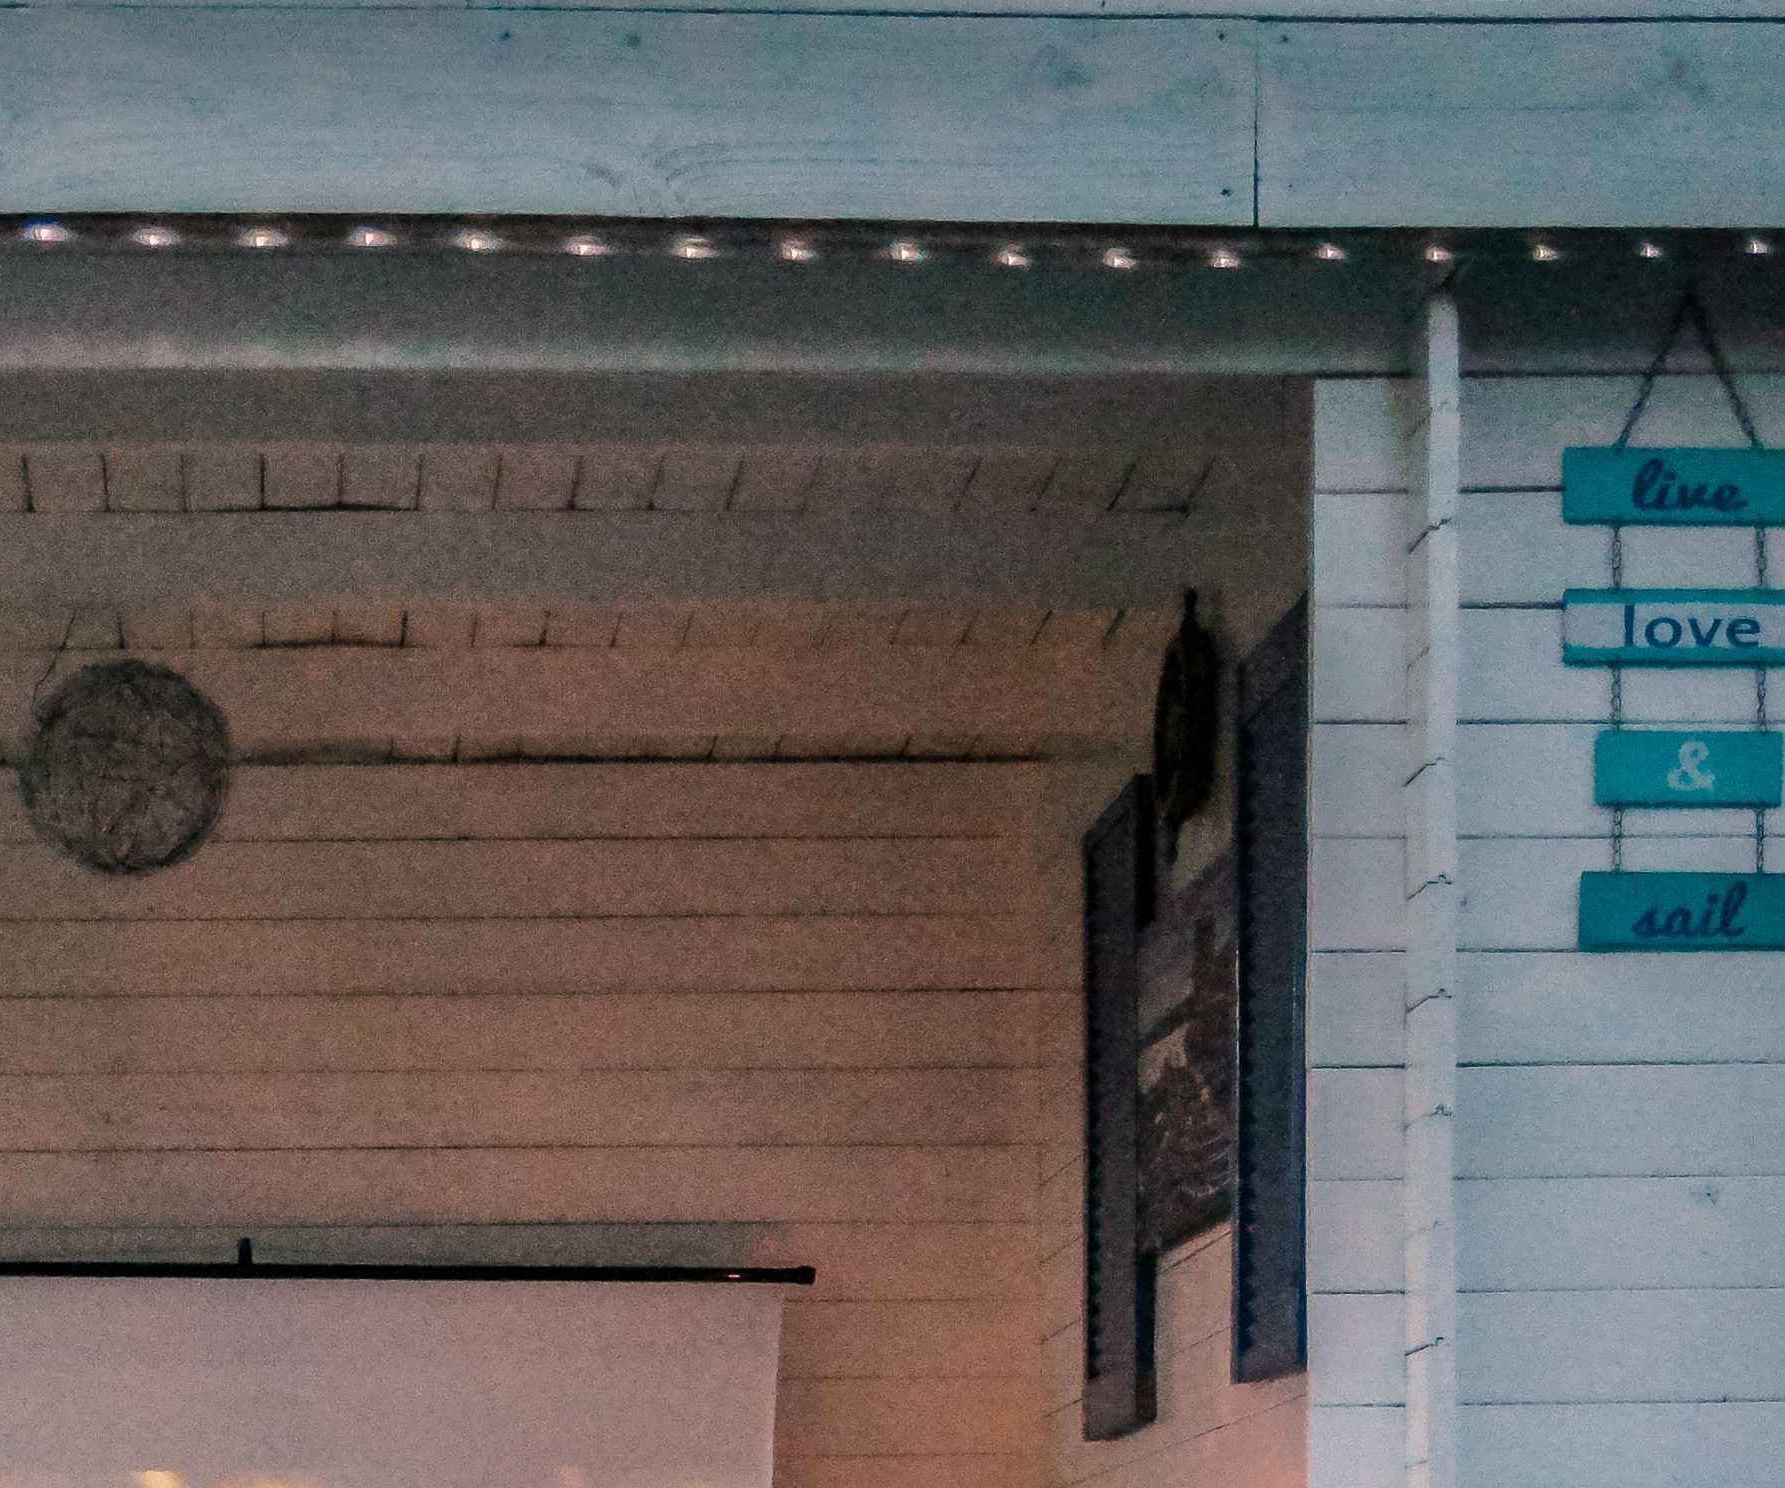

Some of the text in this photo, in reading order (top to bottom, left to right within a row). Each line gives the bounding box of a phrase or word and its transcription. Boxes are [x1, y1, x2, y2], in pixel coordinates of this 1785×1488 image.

[1632, 457, 1748, 512] live
[1624, 604, 1760, 648] love
[1668, 740, 1715, 790] &
[1632, 880, 1747, 939] sail
